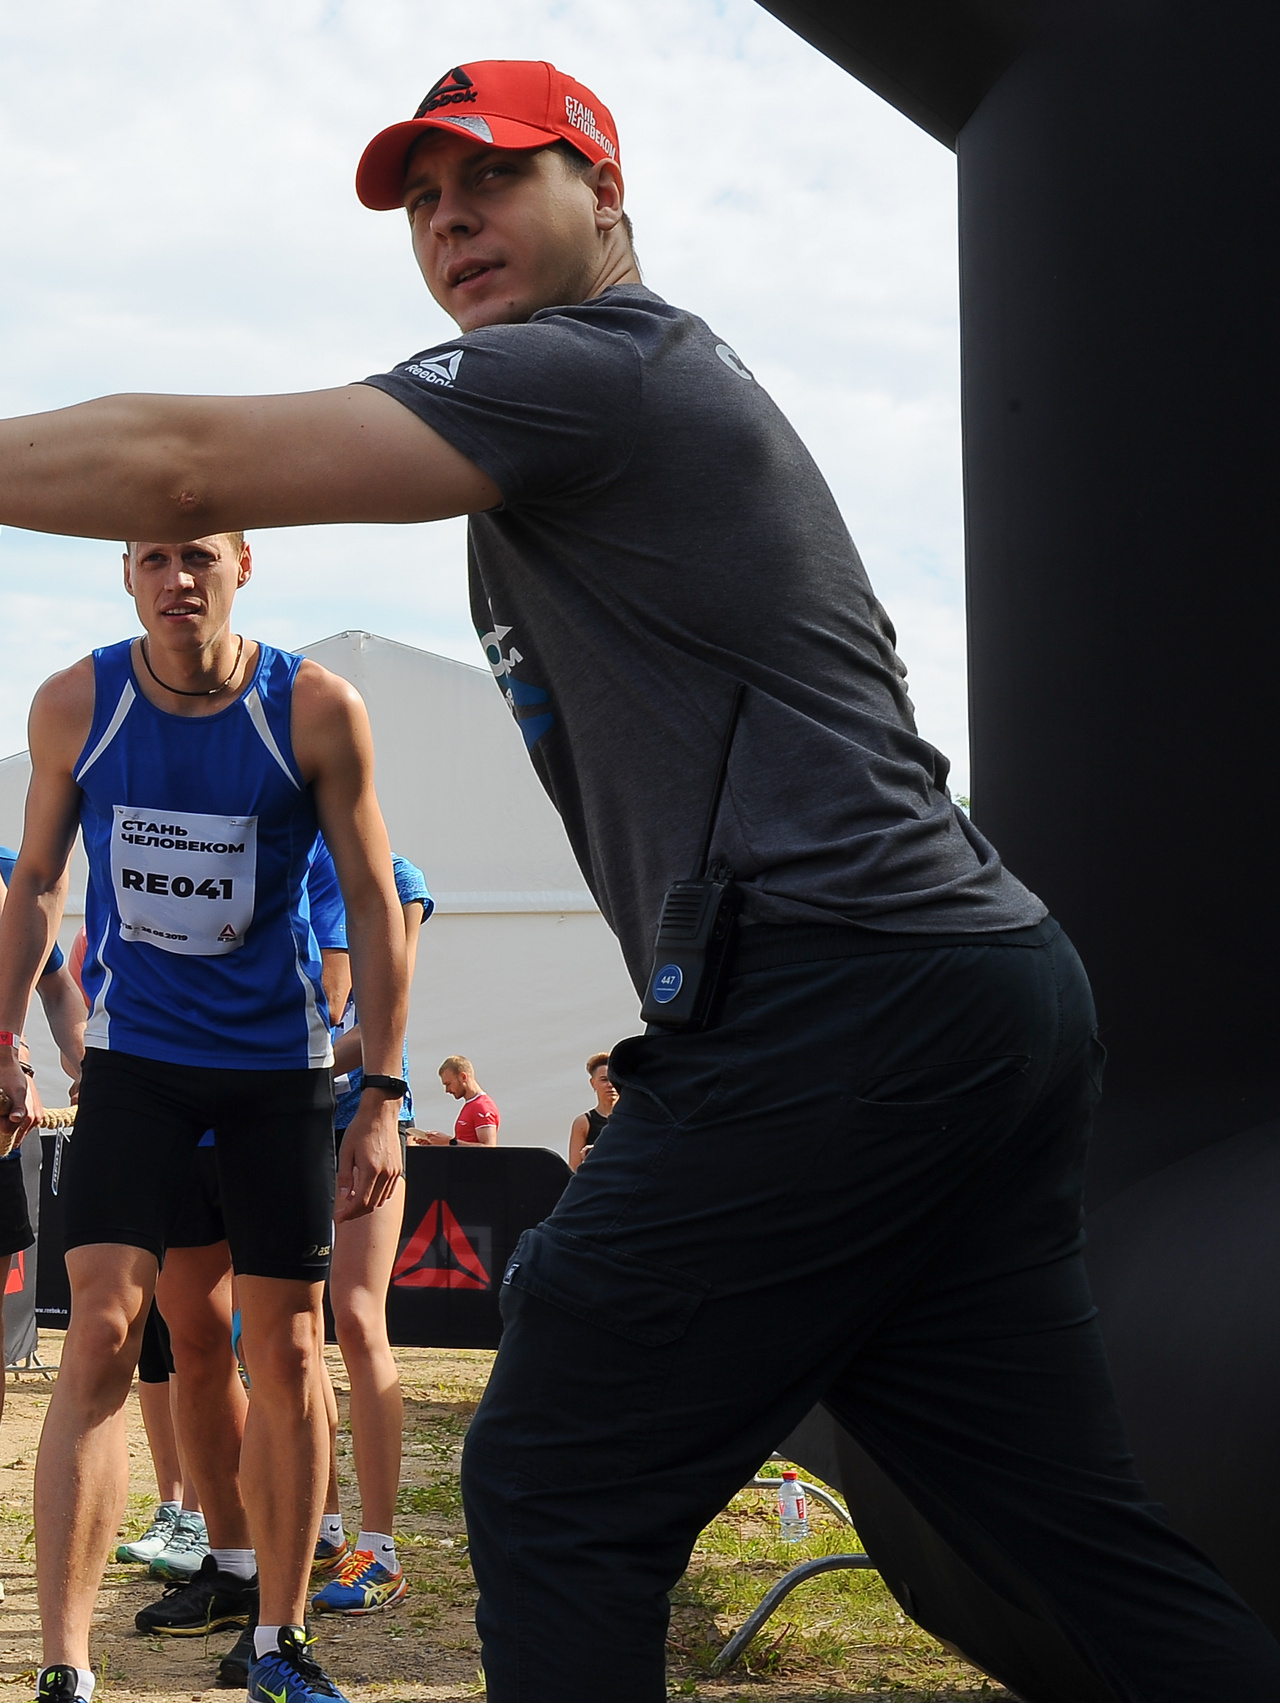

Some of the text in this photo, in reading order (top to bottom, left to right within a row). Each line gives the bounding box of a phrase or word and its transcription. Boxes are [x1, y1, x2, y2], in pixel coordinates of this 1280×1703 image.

[565, 95, 597, 126] СТАНЬ
[565, 107, 616, 160] ЧЕЛОВЕКОМ
[121, 820, 188, 836] СТАНЬ
[121, 834, 245, 853] ЧЕЛОВЕКОМ
[121, 868, 233, 900] RE041
[661, 975, 676, 985] 447
